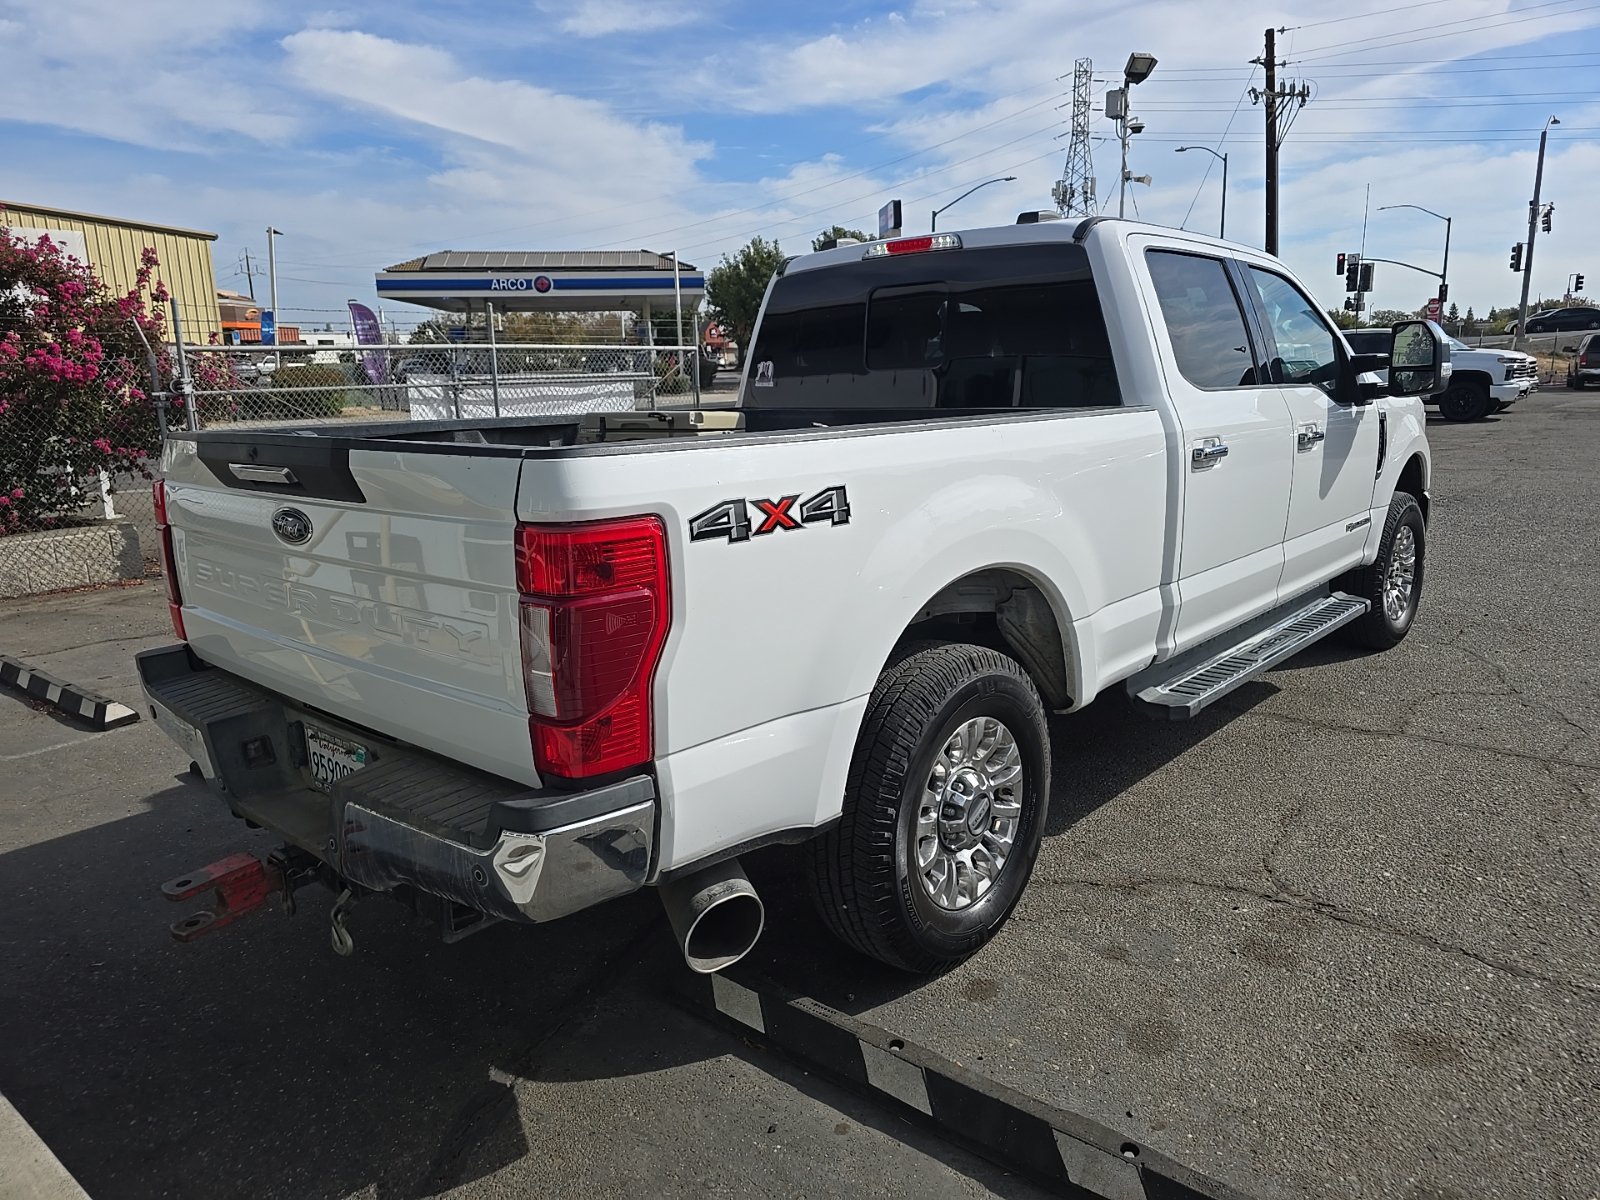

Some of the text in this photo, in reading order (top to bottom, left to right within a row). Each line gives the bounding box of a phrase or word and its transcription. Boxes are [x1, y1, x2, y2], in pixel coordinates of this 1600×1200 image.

[491, 278, 527, 290] ARCO
[274, 515, 300, 538] Ford
[195, 562, 484, 653] SUPER DUTY
